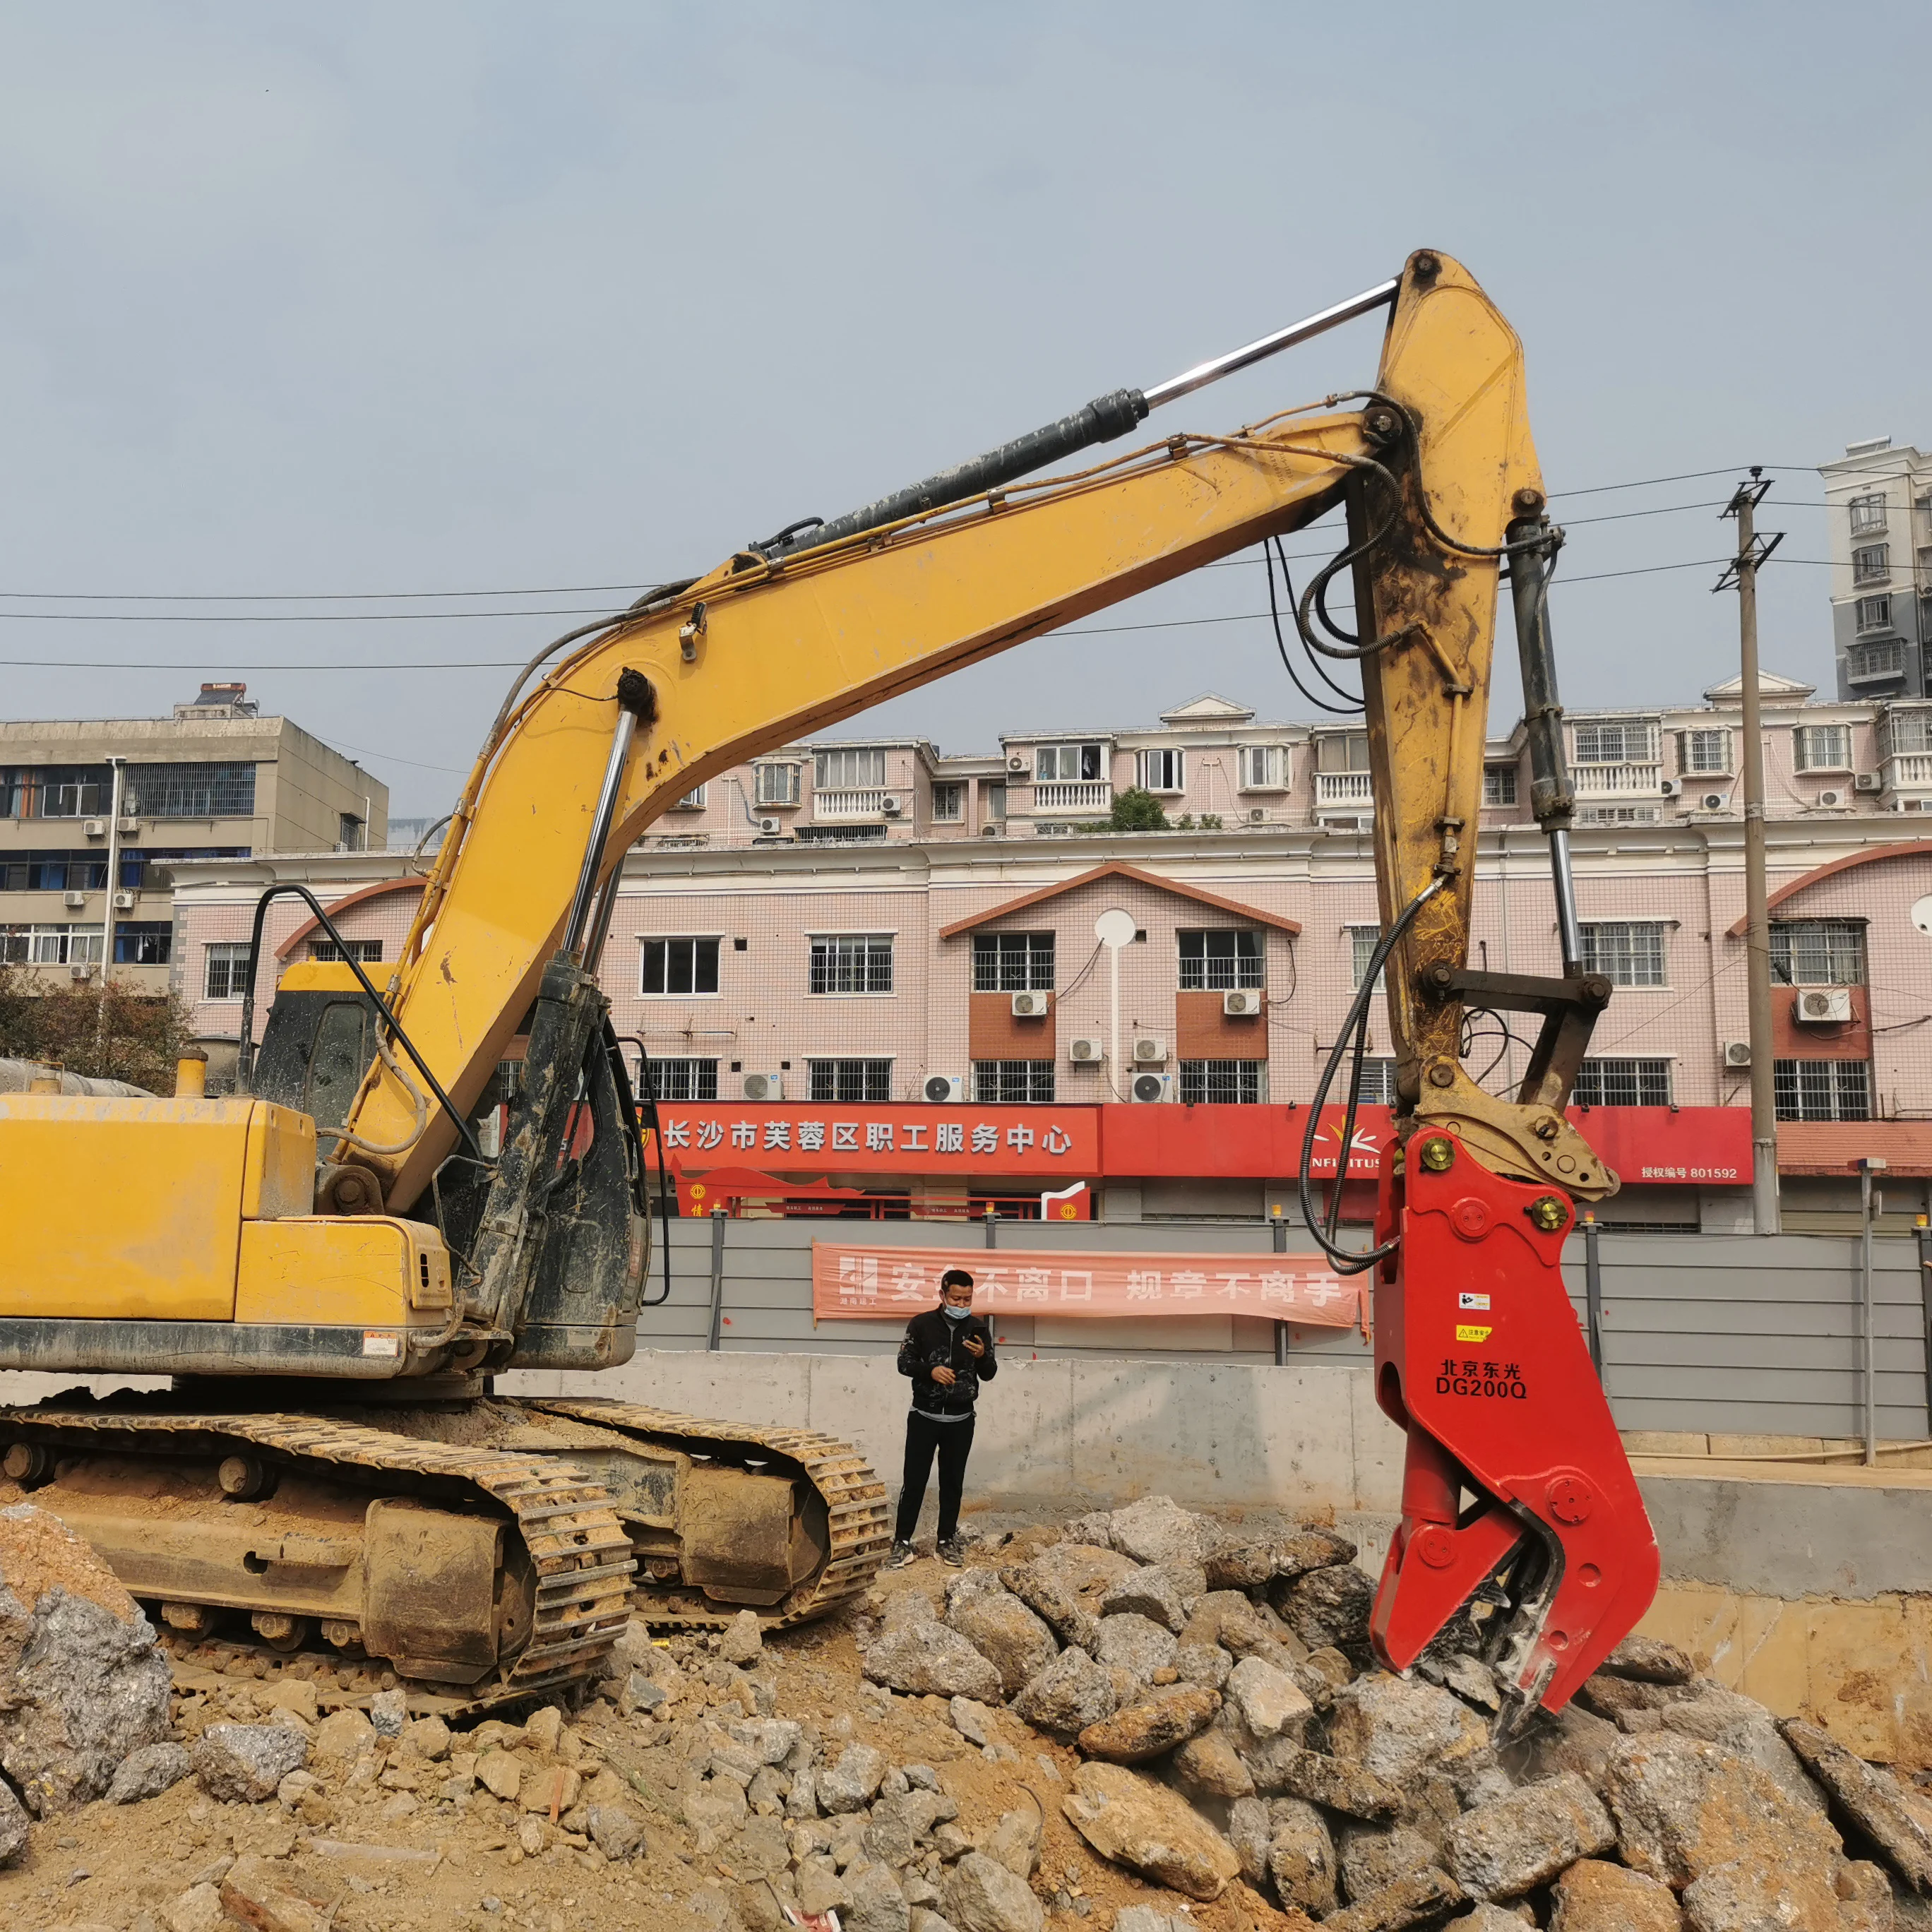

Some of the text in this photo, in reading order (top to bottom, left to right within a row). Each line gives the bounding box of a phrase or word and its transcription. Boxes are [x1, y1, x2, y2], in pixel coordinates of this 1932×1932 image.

[663, 1119, 1072, 1155] 长沙市芙蓉区职工服务中心
[1311, 1157, 1380, 1168] NFIITUS
[1641, 1167, 1737, 1179] 授权编号 801592
[1126, 1269, 1342, 1307] 规章不离手
[1441, 1359, 1521, 1381] 北京东光
[1436, 1376, 1527, 1400] DG200Q
